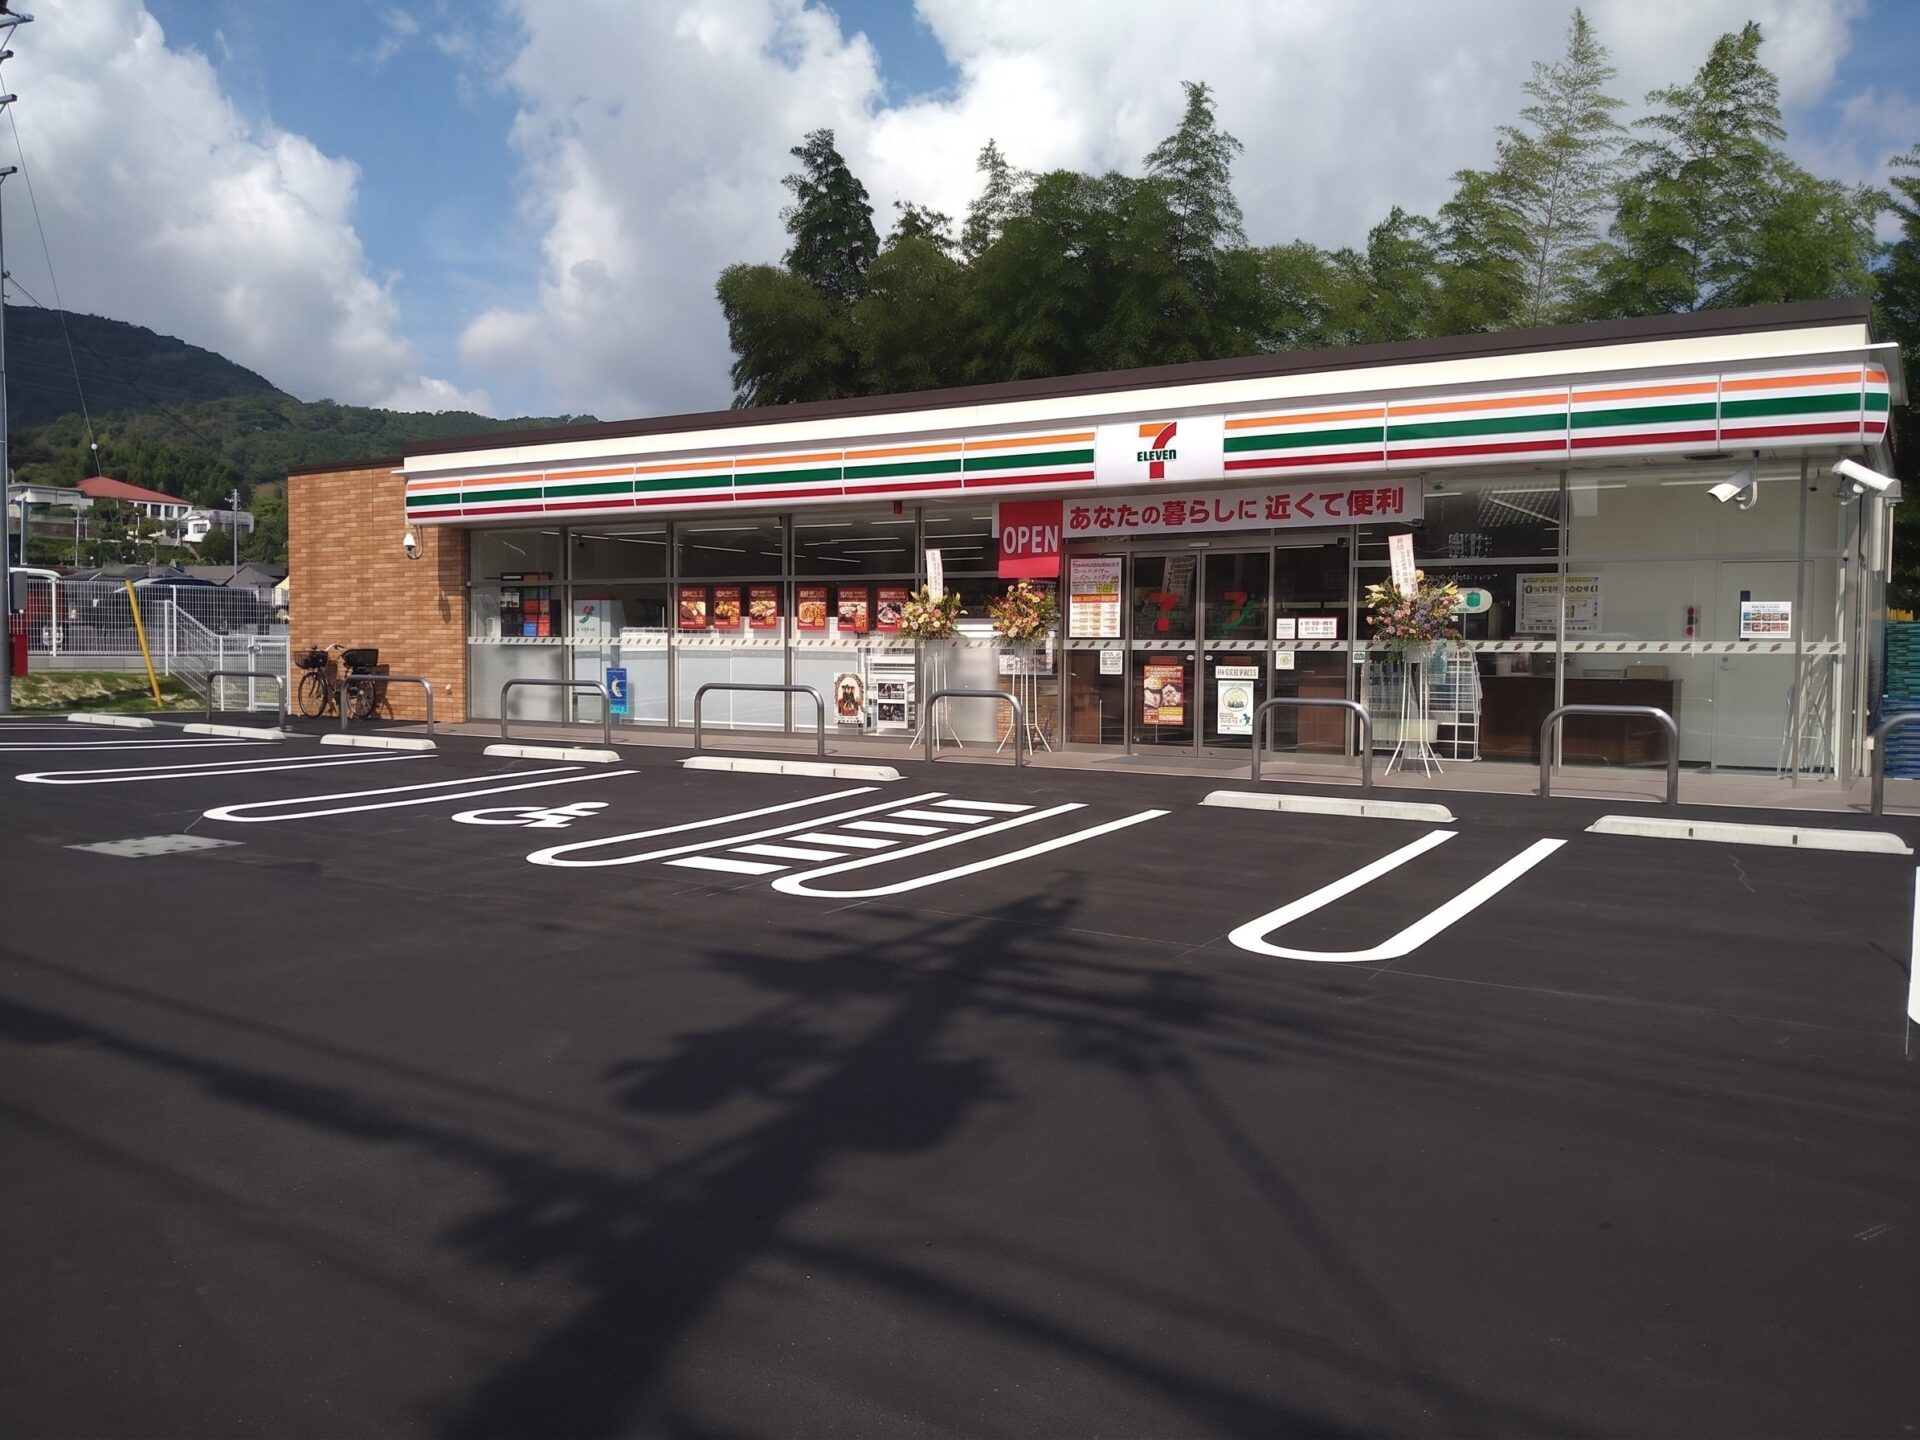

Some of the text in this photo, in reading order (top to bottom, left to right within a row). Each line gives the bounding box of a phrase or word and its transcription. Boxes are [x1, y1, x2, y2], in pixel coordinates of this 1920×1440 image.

[1069, 487, 1404, 530] あなたの暮らしに 近くて便利
[1003, 525, 1059, 554] OPEN
